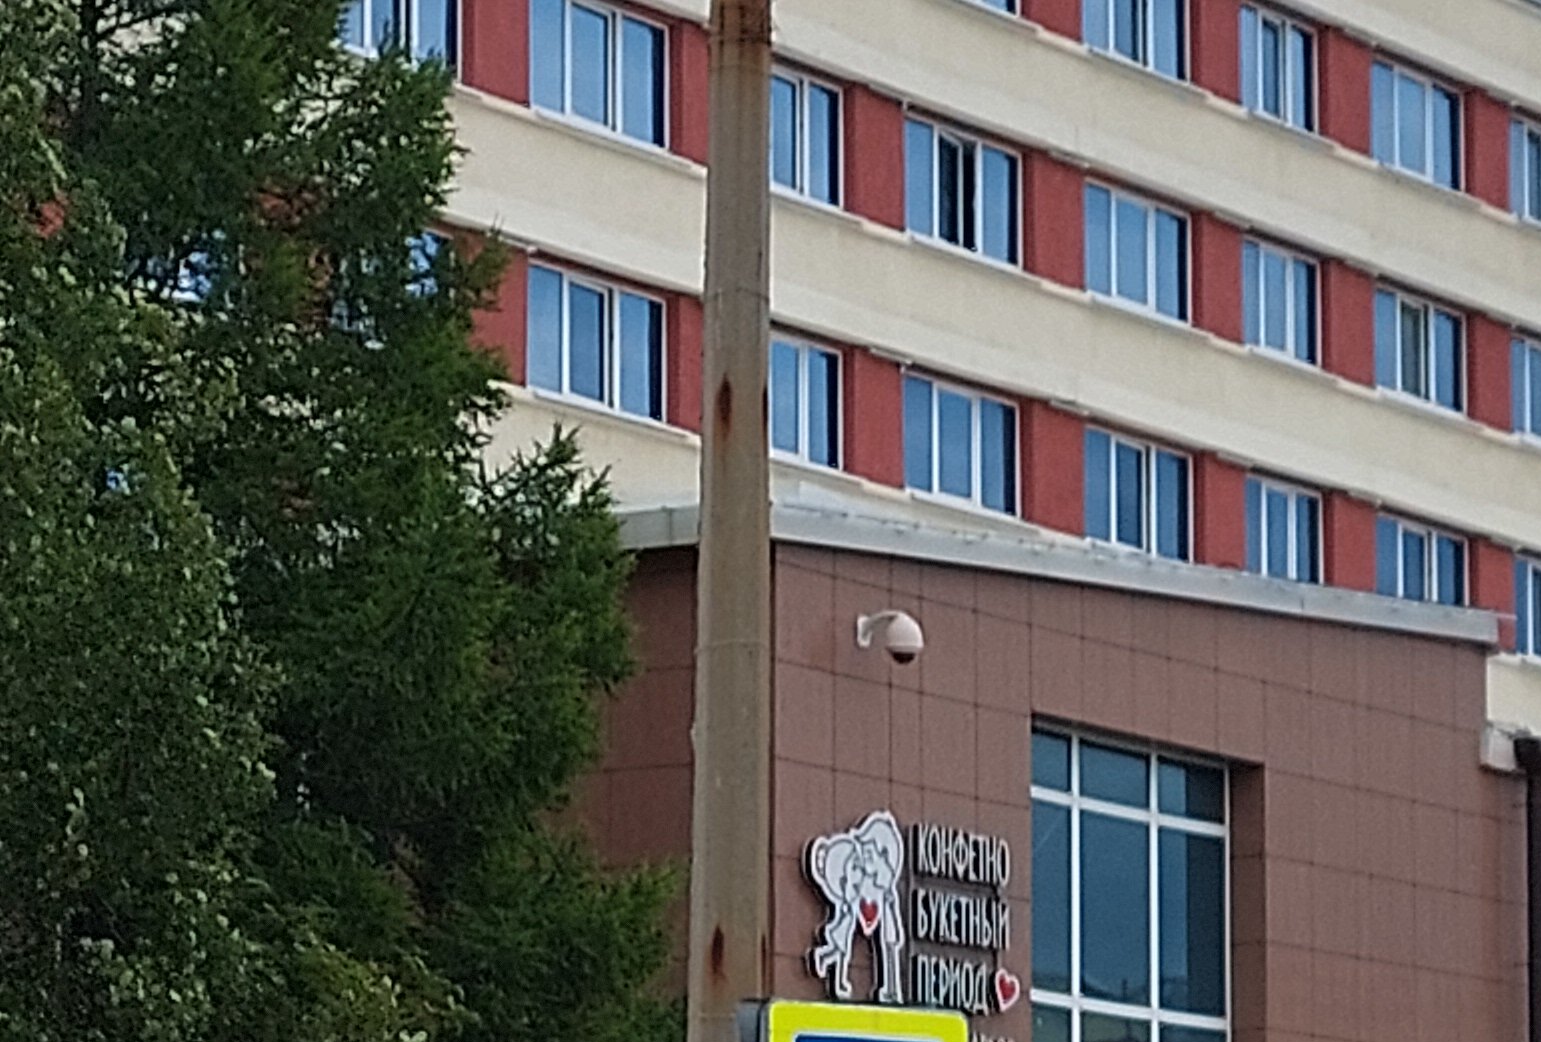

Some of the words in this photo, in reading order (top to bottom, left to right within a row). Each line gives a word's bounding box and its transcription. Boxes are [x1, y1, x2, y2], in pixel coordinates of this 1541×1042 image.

[916, 823, 1010, 887] КОНФЕТНО
[916, 888, 1010, 950] БУКЕТНЫЙ
[916, 955, 990, 1017] ПЕРИОД
